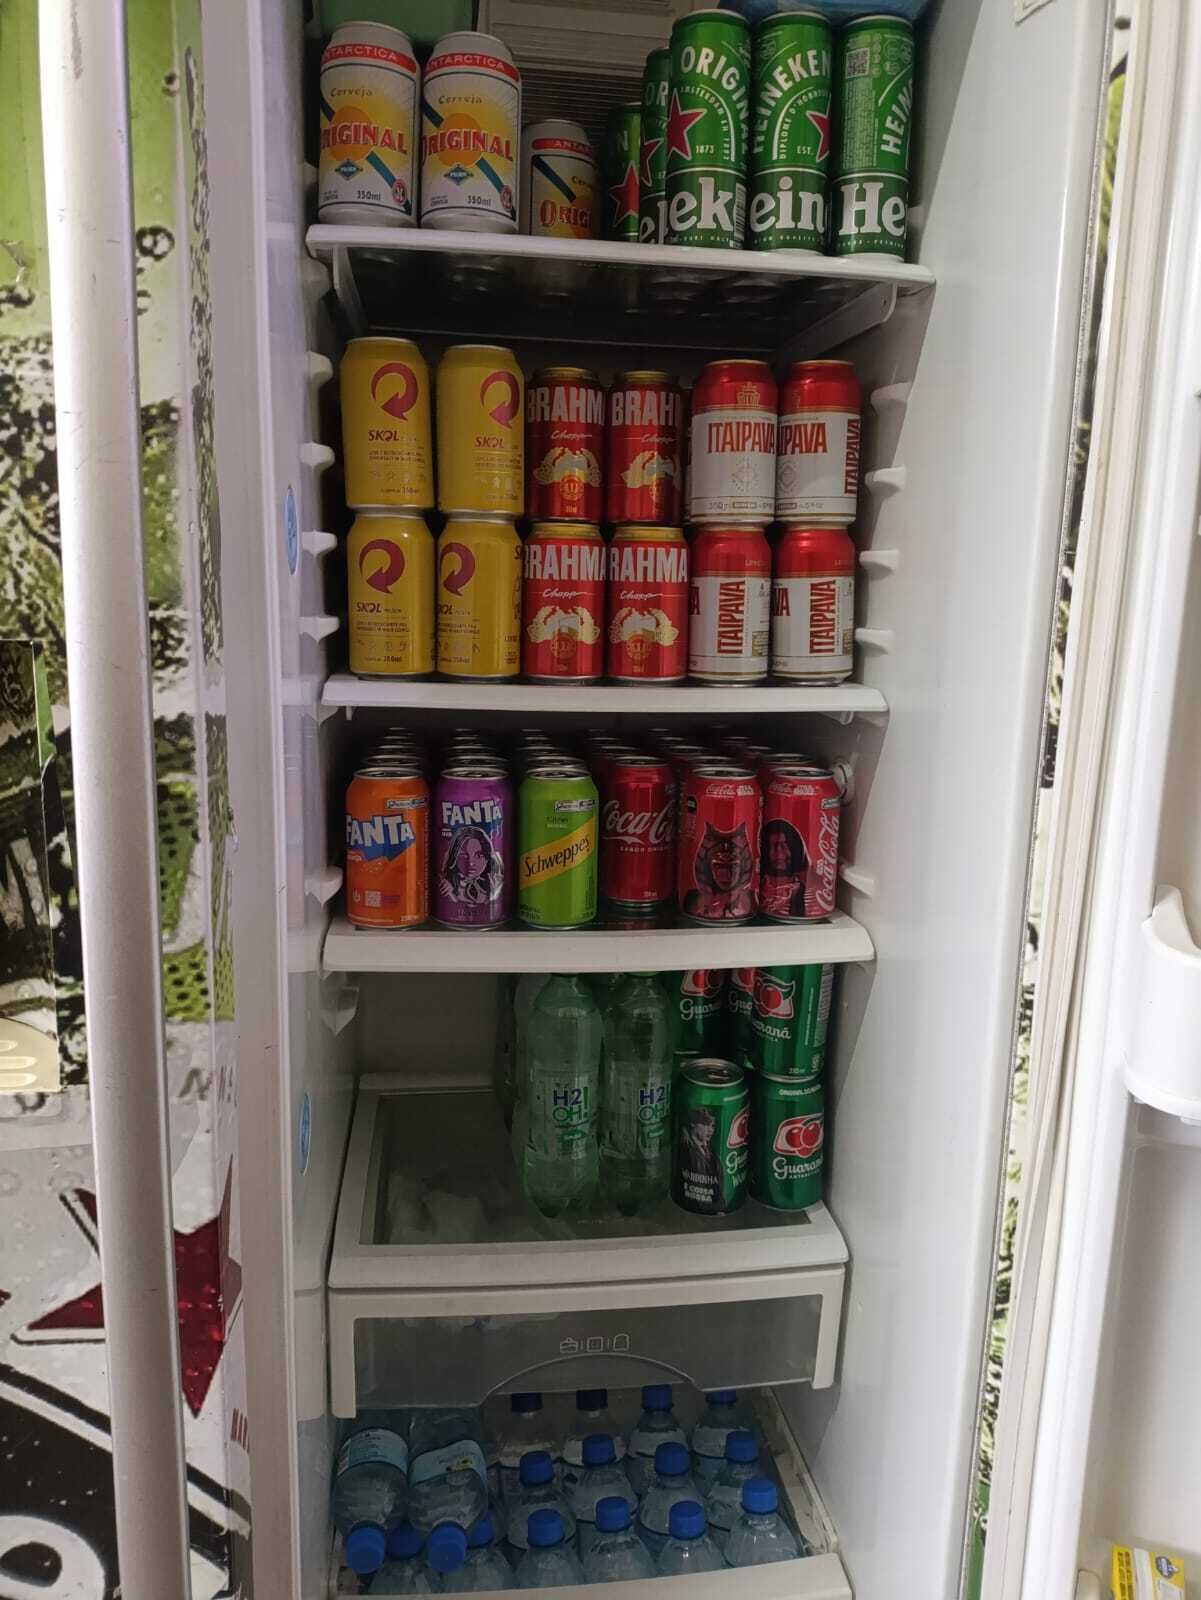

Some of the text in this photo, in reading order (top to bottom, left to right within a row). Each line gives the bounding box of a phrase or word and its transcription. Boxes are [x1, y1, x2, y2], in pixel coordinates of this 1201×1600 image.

[427, 55, 505, 71] NTARCTICA
[527, 385, 606, 426] BRAHM
[844, 418, 860, 495] ITAIPAVA
[717, 580, 746, 655] ITAIPAVA
[809, 579, 837, 655] ITAIPAVA
[441, 799, 503, 826] FANTA
[524, 837, 592, 878] Schweppes
